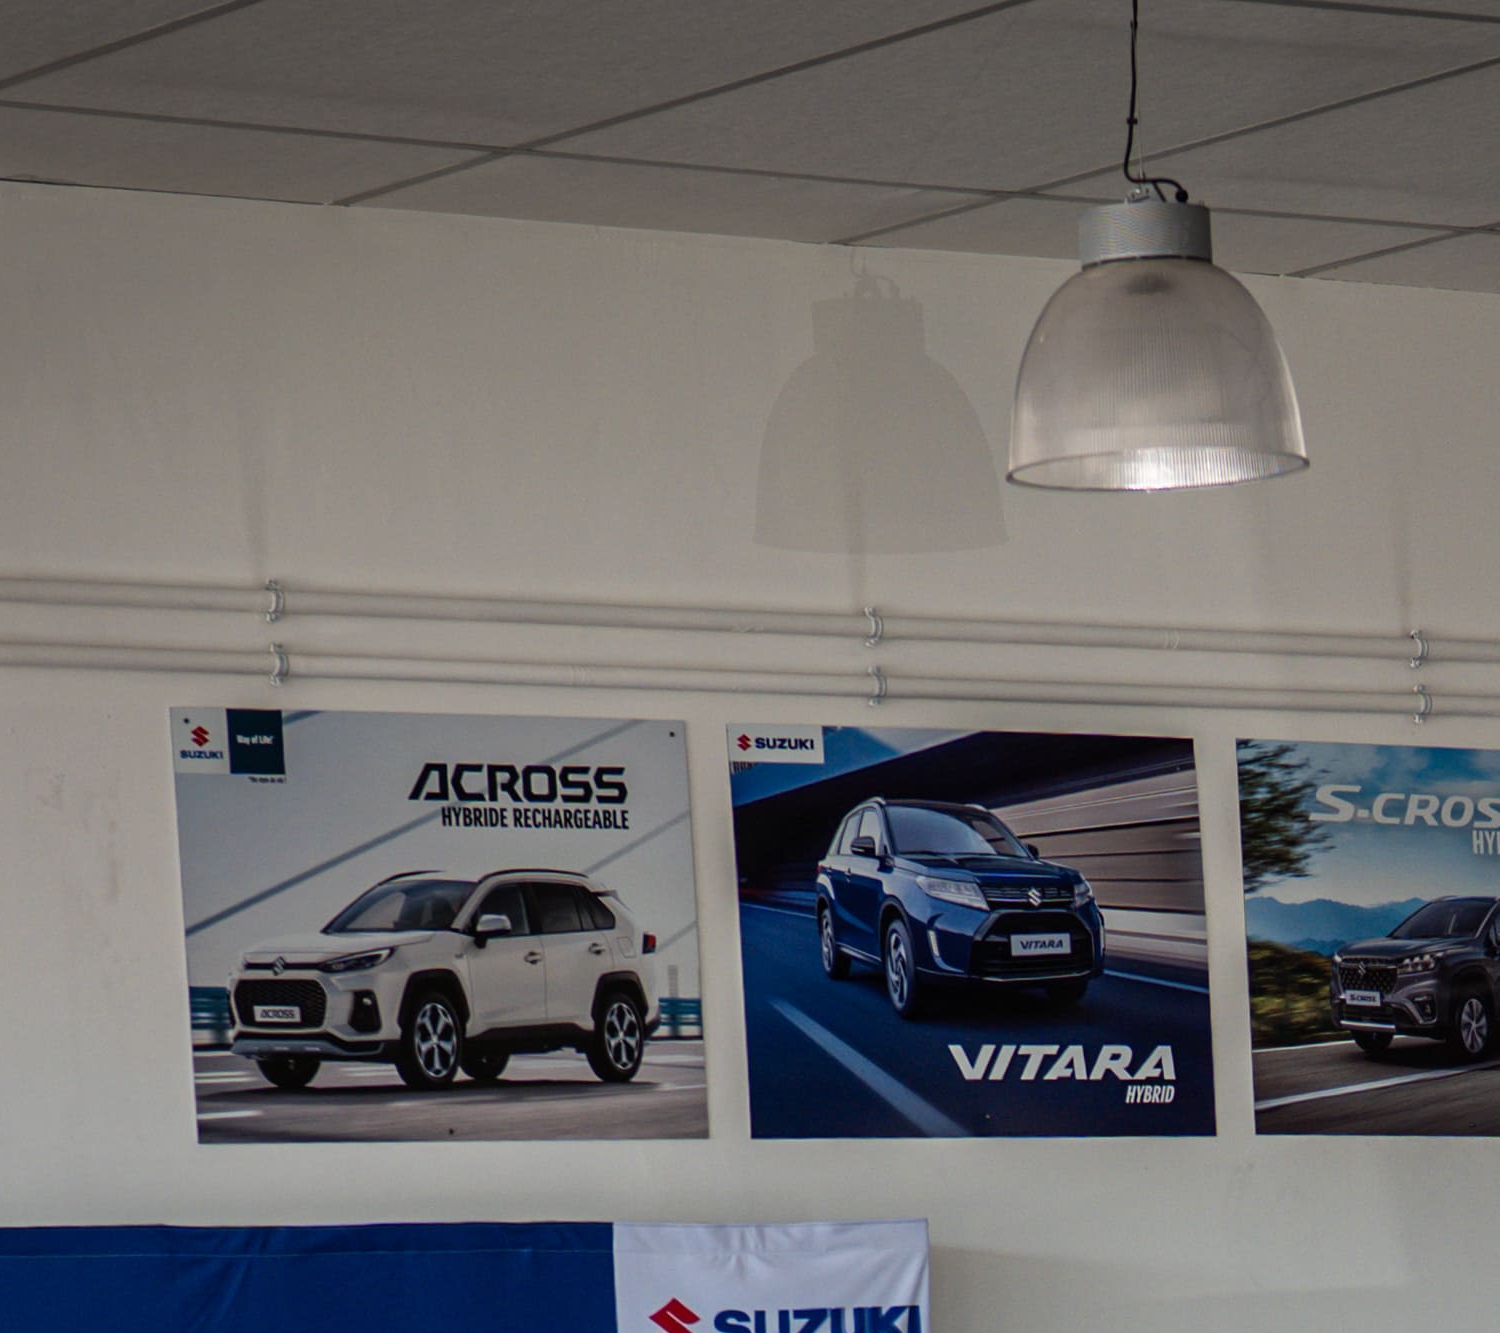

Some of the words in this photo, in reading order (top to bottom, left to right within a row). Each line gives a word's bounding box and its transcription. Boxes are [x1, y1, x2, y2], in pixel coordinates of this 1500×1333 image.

[754, 737, 815, 750] SUZUKI
[180, 750, 224, 759] SUZUKI
[408, 763, 628, 804] ACROSS
[441, 807, 508, 828] HYBRIDE
[513, 808, 630, 830] RECHARGEABLE
[1020, 939, 1064, 950] VITARA
[947, 1044, 1176, 1081] VITARA
[1125, 1085, 1175, 1104] HYBRID
